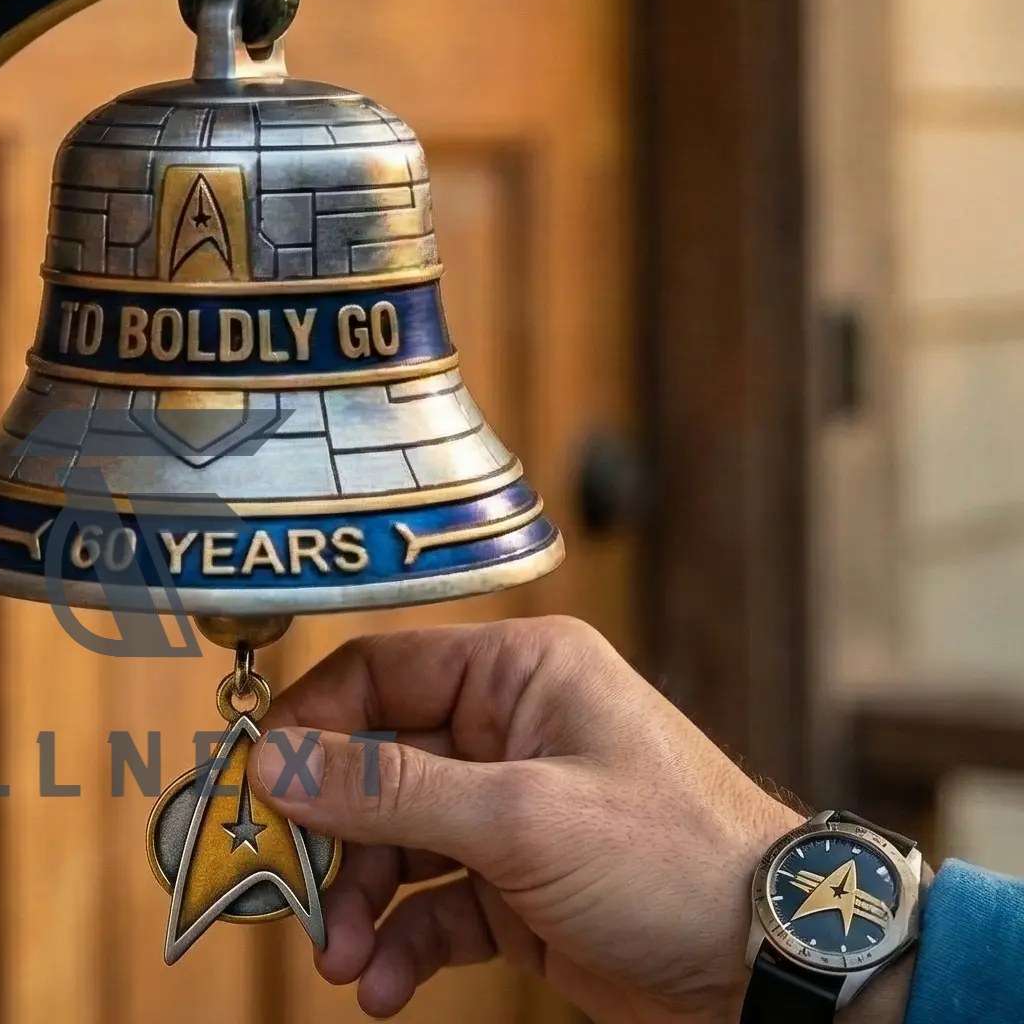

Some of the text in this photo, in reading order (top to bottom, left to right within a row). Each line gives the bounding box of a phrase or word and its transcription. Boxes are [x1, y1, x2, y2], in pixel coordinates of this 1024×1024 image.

[60, 301, 400, 361] TO BOLDLY GO
[69, 526, 368, 573] 60 YEARS
